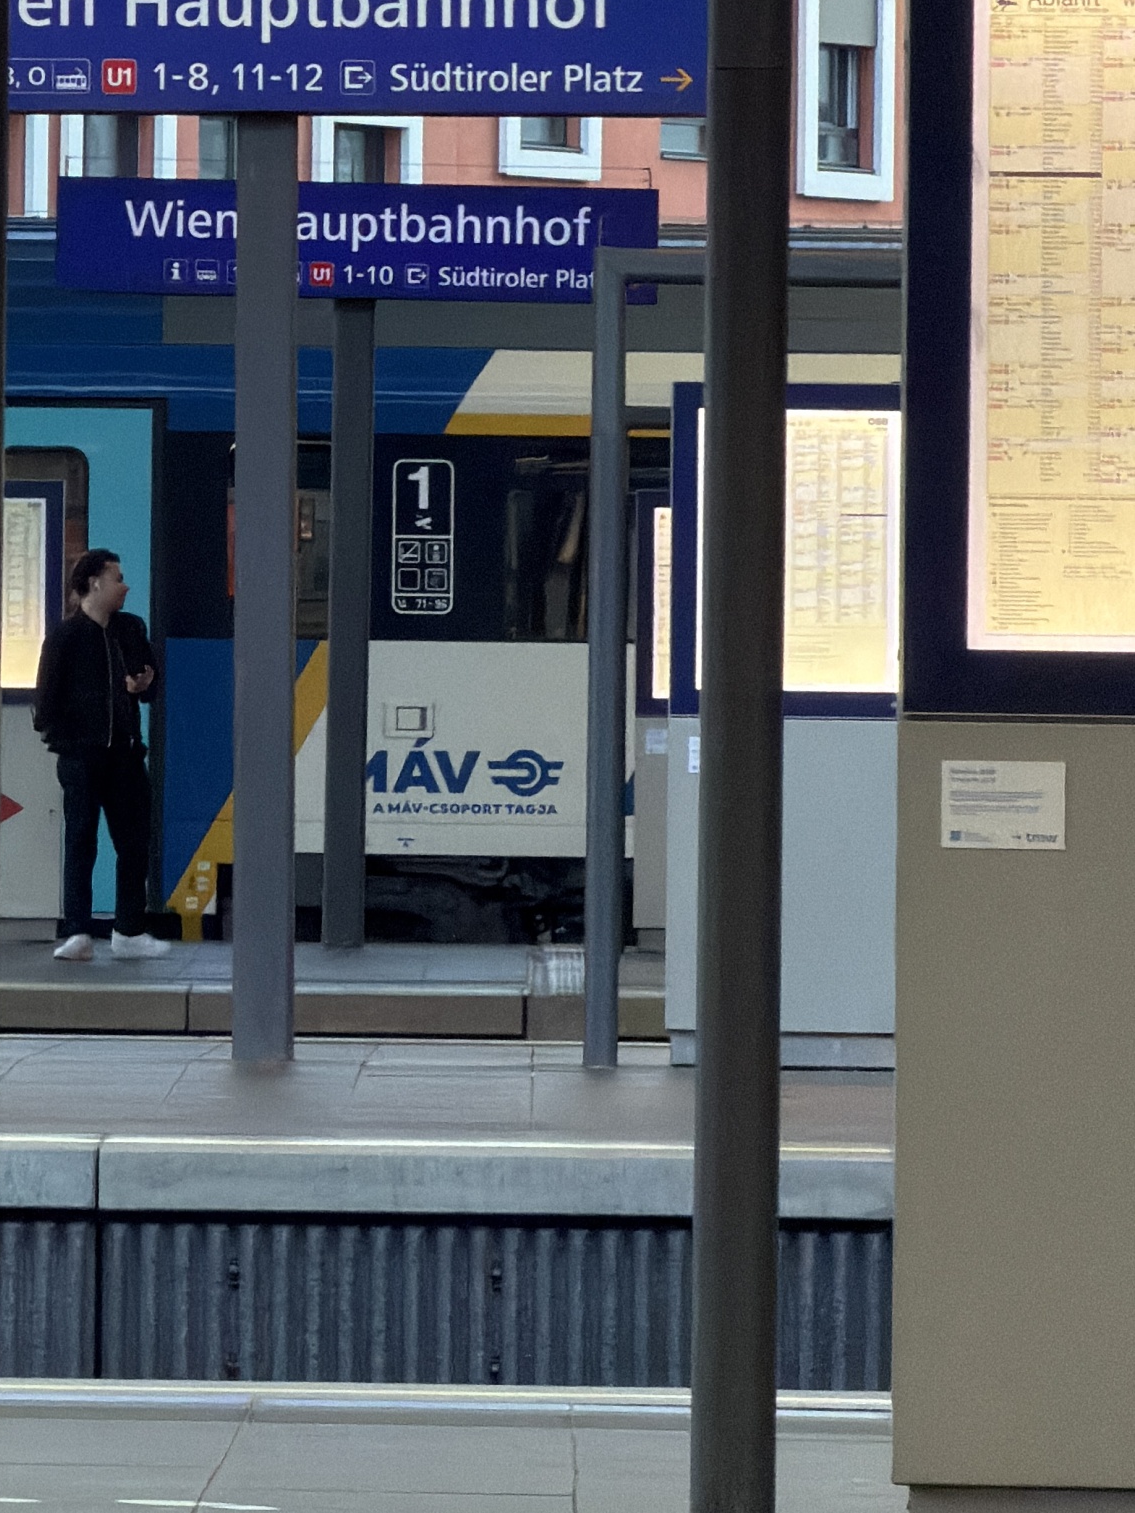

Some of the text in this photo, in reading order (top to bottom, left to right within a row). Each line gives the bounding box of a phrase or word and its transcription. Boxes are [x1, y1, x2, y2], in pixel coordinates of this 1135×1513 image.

[107, 67, 132, 86] U1
[153, 62, 219, 95] 1-8,
[232, 63, 323, 91] 11-12
[390, 62, 553, 92] Südtiroler
[564, 63, 643, 93] Platz
[125, 199, 592, 253] Wien auptbahnhof
[313, 267, 332, 282] U1
[343, 264, 394, 285] 1-10
[438, 266, 549, 289] Südtiroler
[407, 466, 430, 510] 1
[504, 803, 558, 815] TAGJA
